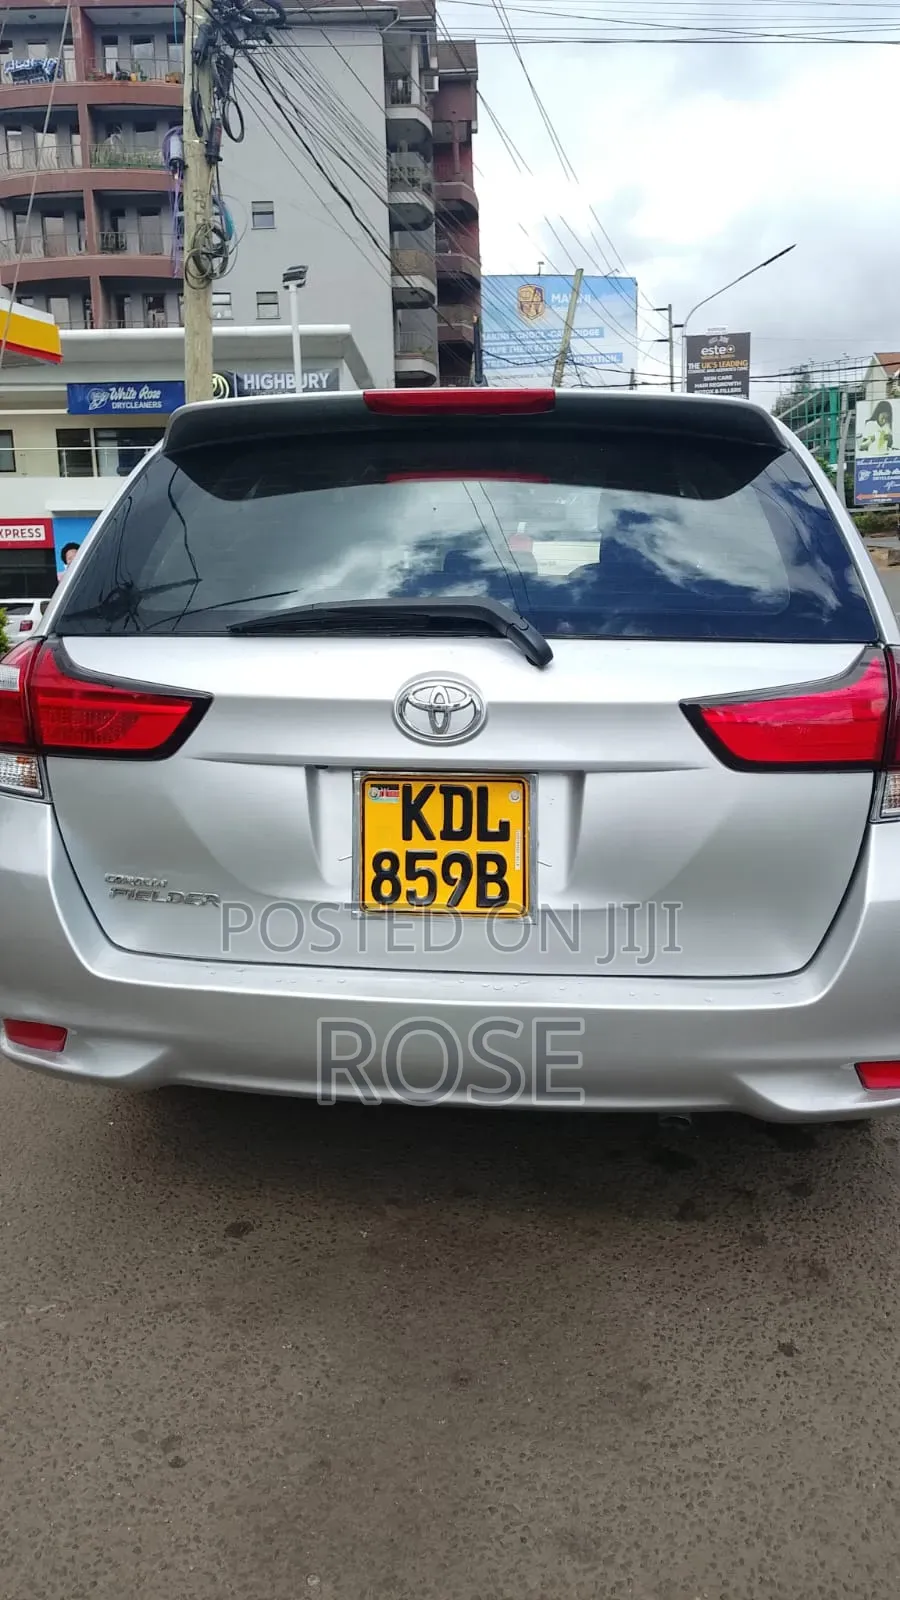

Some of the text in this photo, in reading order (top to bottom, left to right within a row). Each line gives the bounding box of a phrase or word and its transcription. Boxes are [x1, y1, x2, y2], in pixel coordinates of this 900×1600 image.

[402, 783, 511, 842] KDL
[109, 887, 220, 908] FIELDER
[371, 850, 510, 908] 859B
